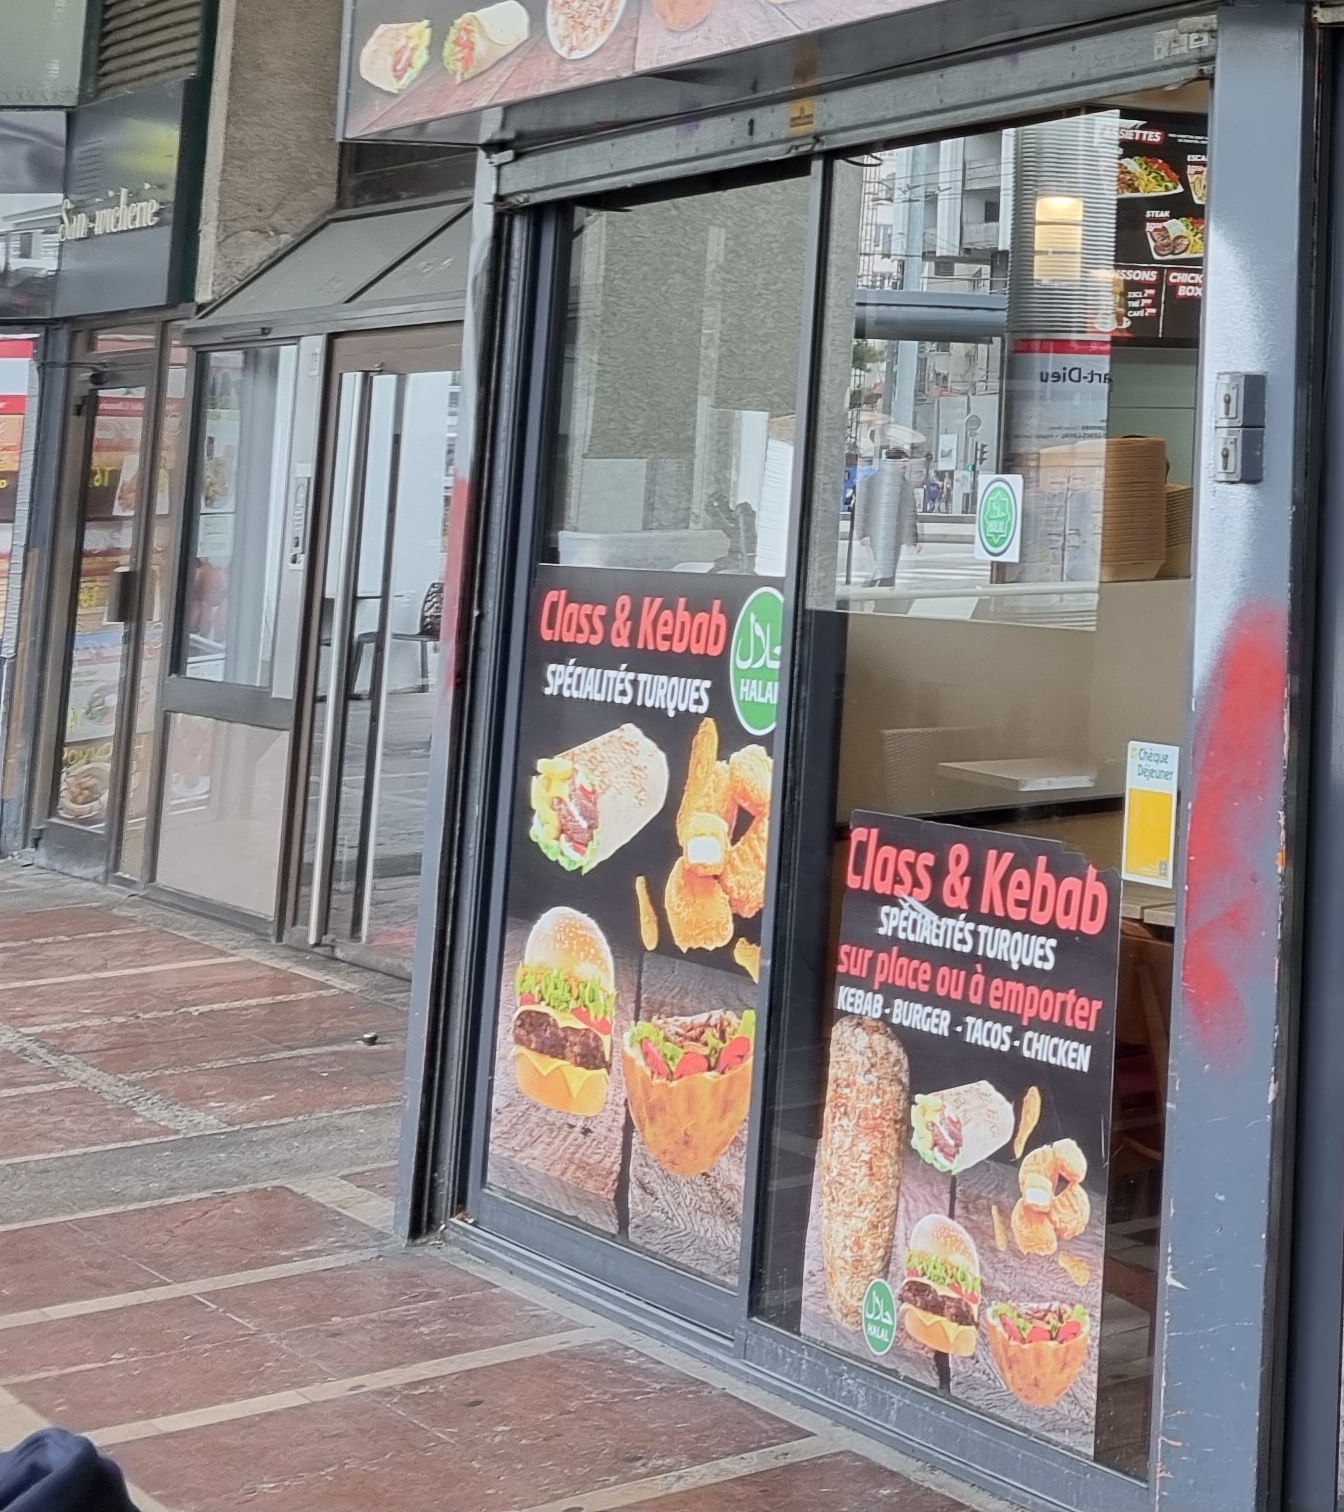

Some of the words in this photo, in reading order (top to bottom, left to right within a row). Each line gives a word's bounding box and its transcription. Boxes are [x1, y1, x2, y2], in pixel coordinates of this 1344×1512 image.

[540, 589, 607, 646] Class
[611, 594, 632, 648] &
[637, 596, 727, 656] Kebab
[544, 658, 634, 705] SPÉCIALITÉS
[636, 673, 712, 717] TURQUES
[1138, 748, 1169, 766] Chèque
[846, 826, 934, 902] Class
[943, 843, 971, 909] &
[980, 849, 1108, 935] Kebab
[977, 925, 1057, 971] TURQUES
[837, 943, 872, 978] sur
[874, 946, 931, 993] place
[937, 966, 964, 1000] ou
[969, 964, 984, 1004] à
[989, 977, 1103, 1033] emporter
[836, 985, 882, 1019] KEBAB
[892, 997, 951, 1037] BURGER
[965, 1015, 1012, 1052] TACOS
[1022, 1029, 1091, 1073] CHICKEN
[866, 1322, 889, 1343] HALAL
